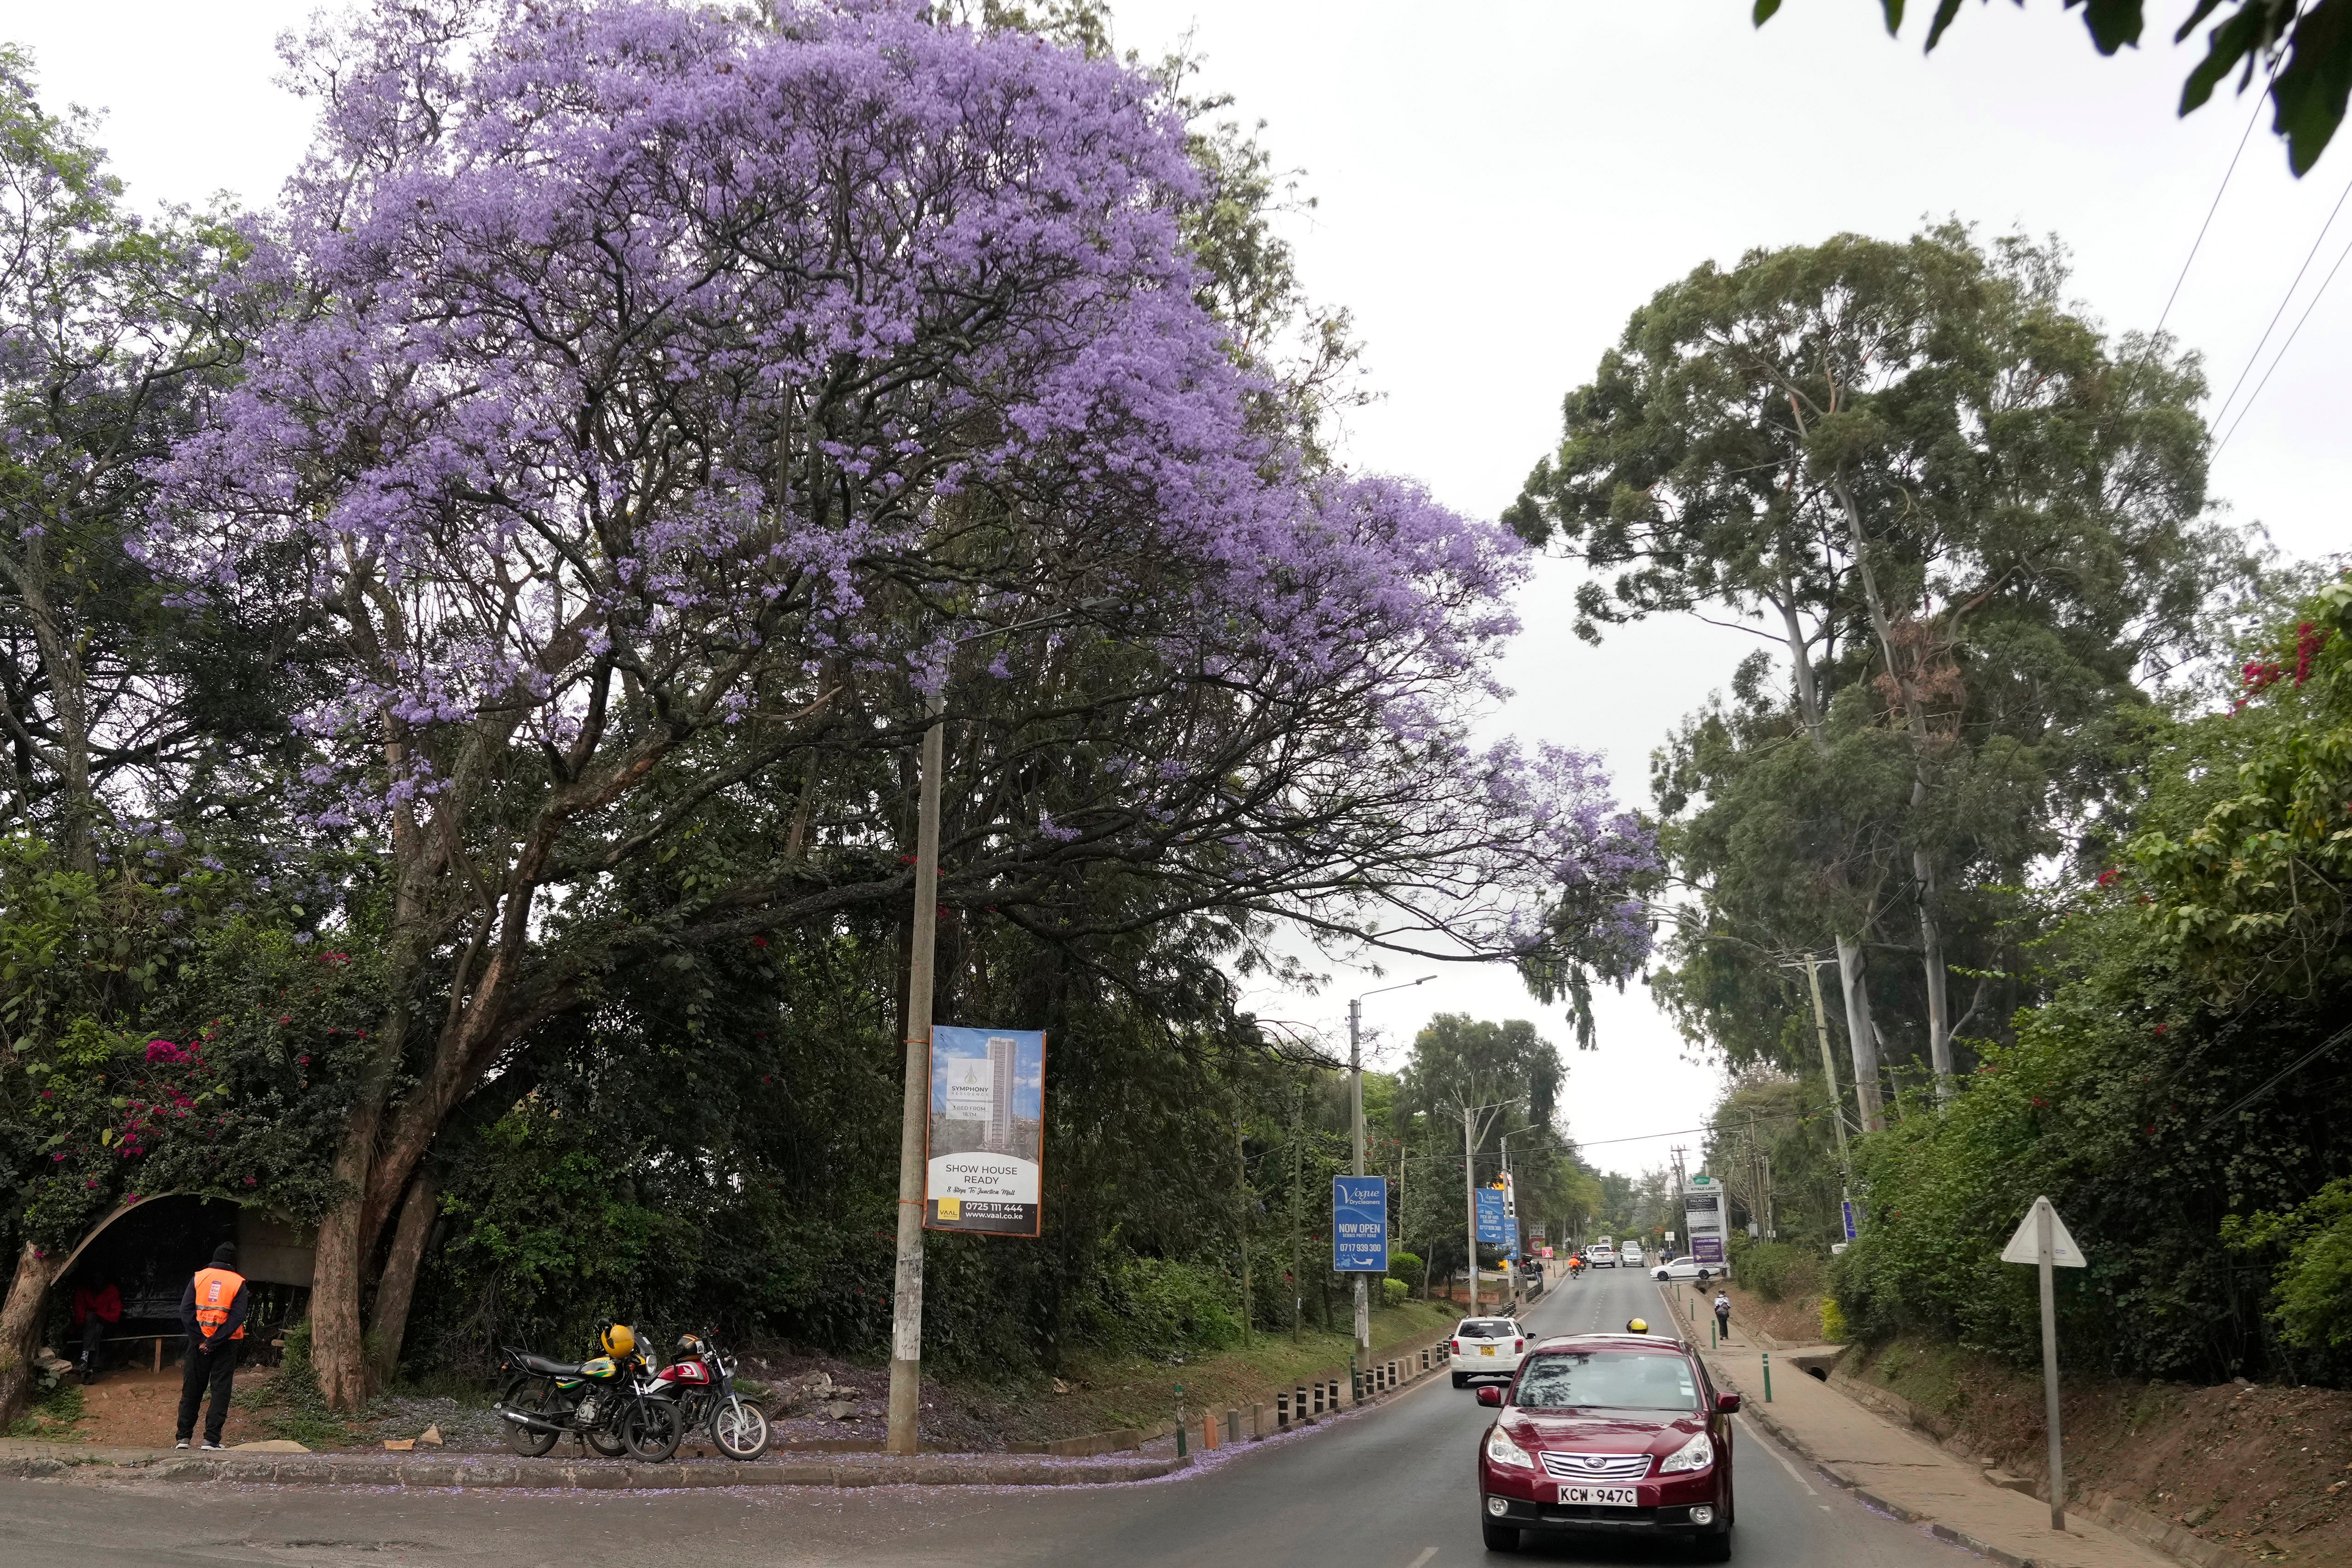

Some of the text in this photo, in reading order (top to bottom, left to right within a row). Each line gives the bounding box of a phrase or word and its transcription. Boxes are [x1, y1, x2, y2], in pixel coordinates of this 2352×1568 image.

[946, 1164, 1018, 1175] SHOW HOUSE
[964, 1176, 999, 1185] READY
[953, 1186, 967, 1195] Steps
[1336, 1185, 1379, 1204] Vogue
[966, 1202, 1023, 1213] 0725 111 444
[965, 1212, 1023, 1220] www.vaal.co.ke
[1339, 1224, 1380, 1233] NOW OPEN
[1340, 1243, 1381, 1252] 0717 939 300
[1561, 1488, 1633, 1503] KCW 947C
